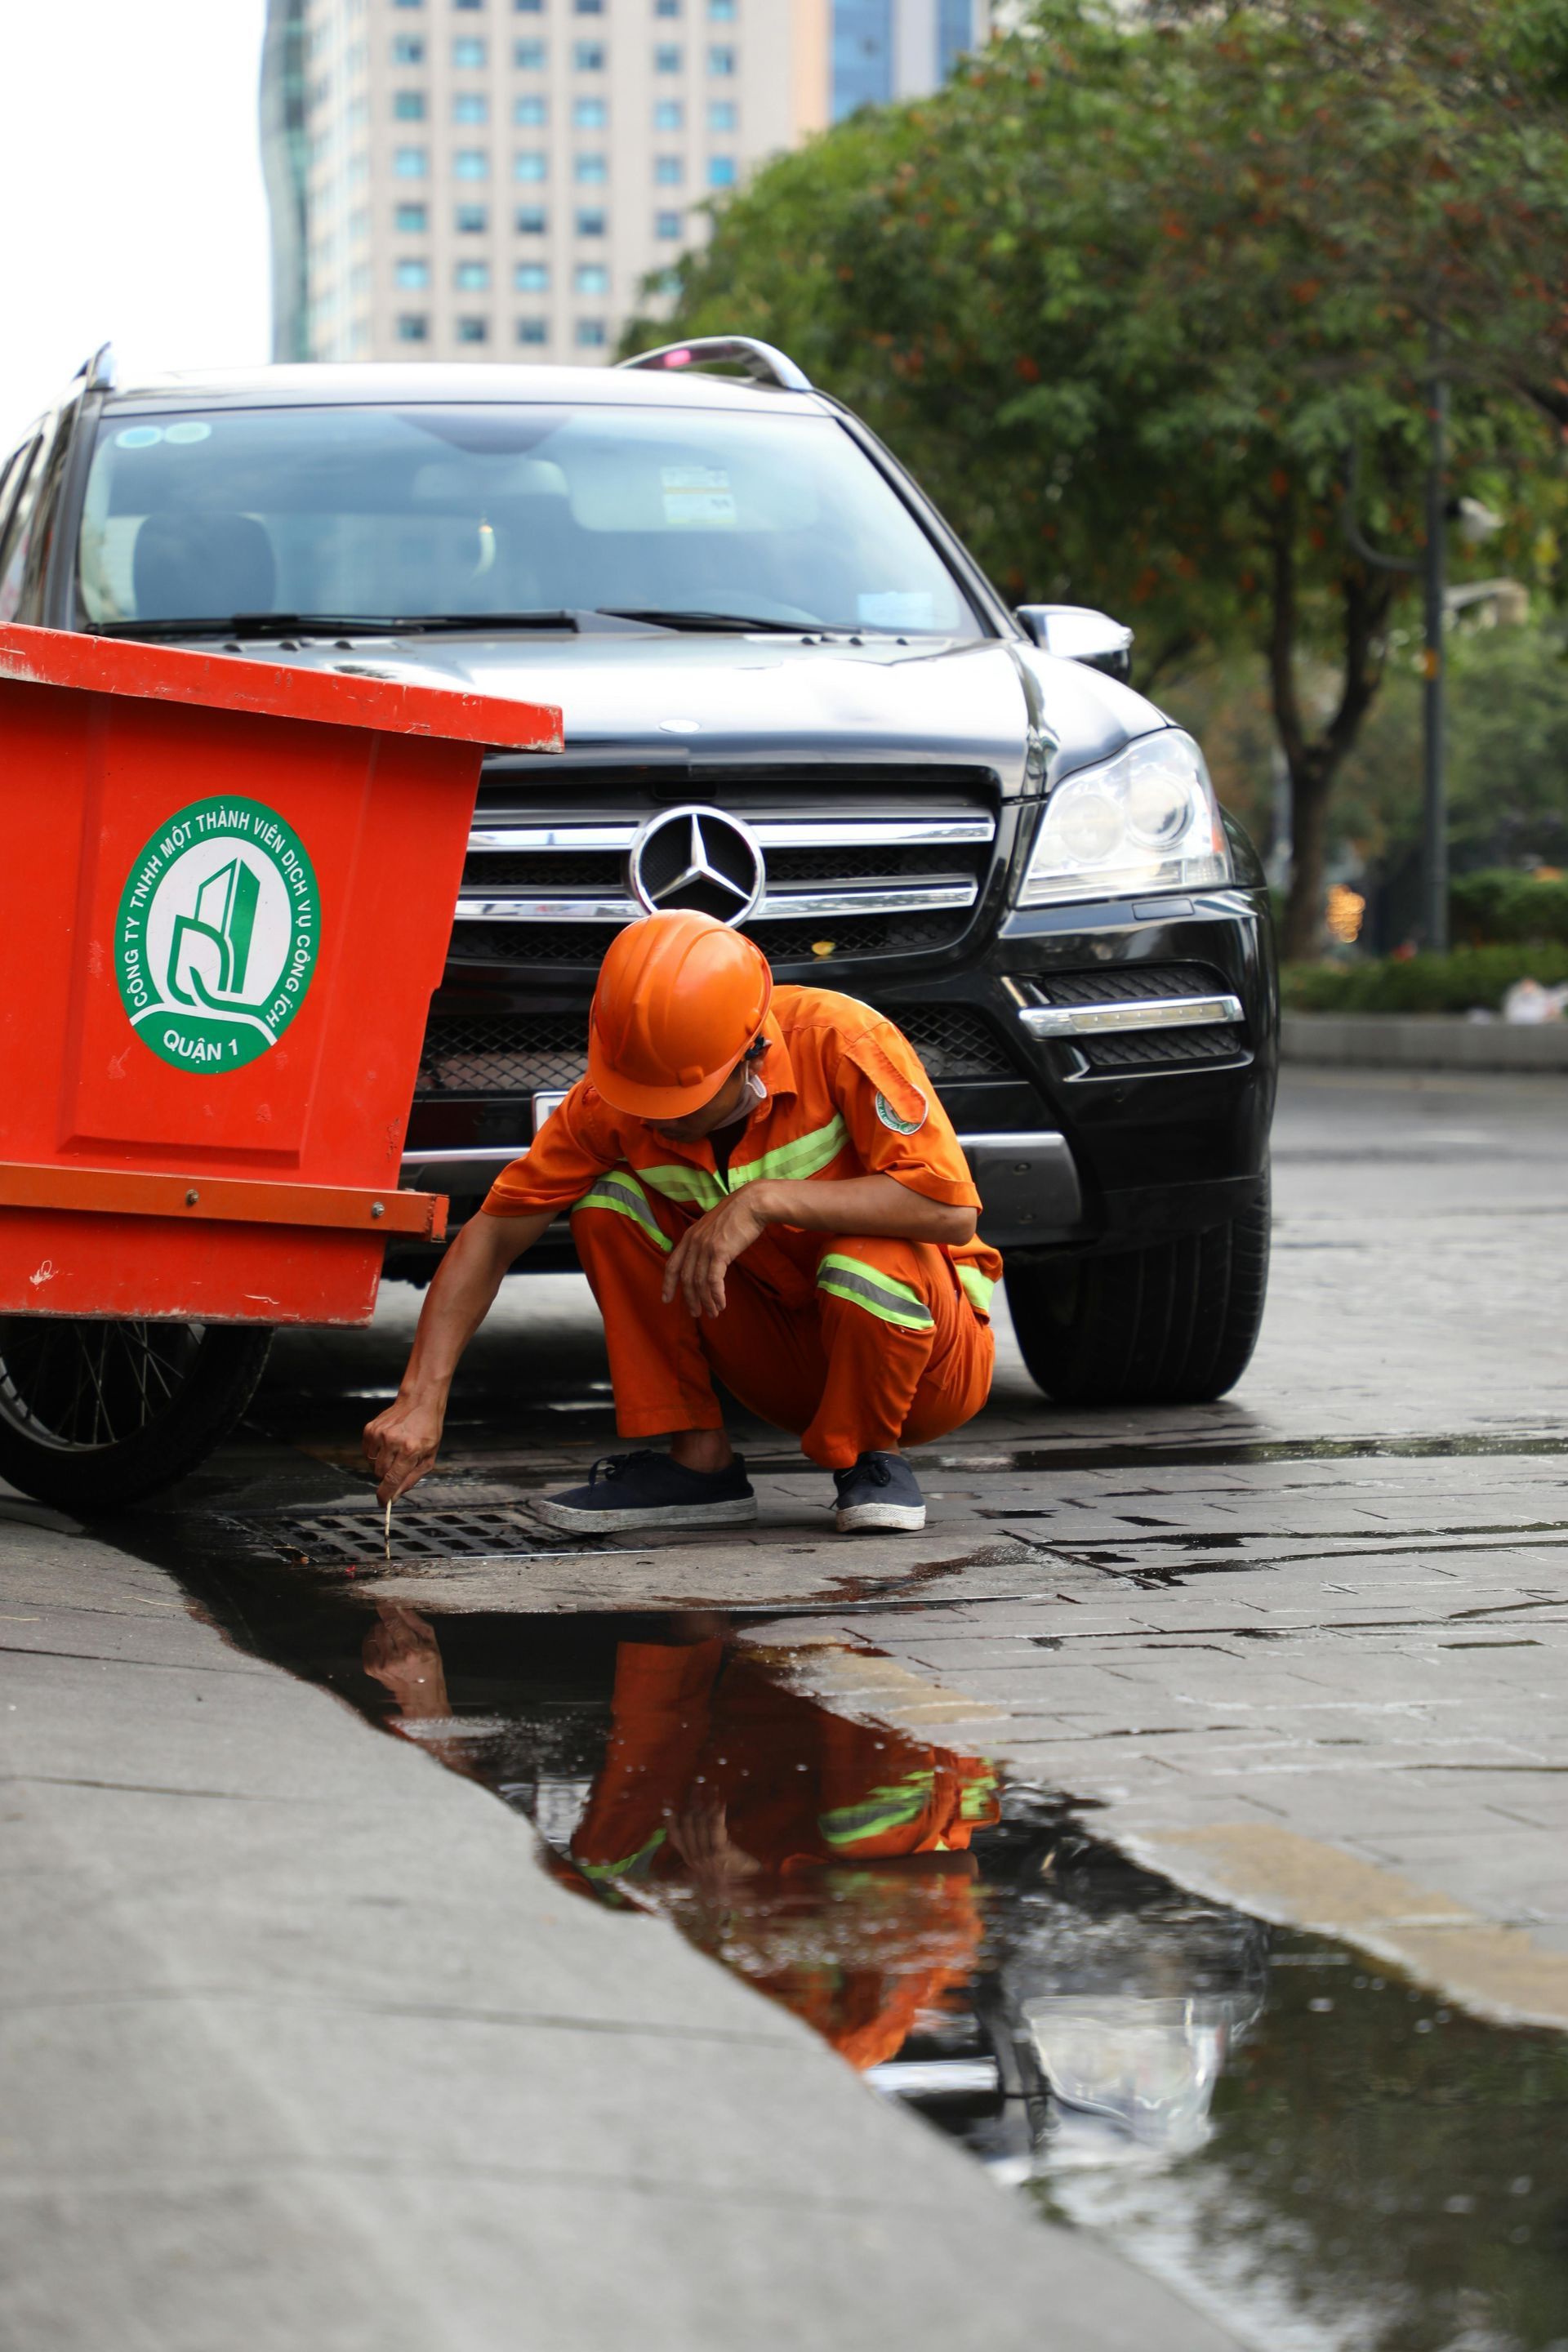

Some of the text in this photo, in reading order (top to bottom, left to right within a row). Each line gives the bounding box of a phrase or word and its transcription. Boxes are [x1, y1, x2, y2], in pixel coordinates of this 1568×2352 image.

[124, 805, 311, 1028] CÔNG TY TNHH MỘT THÀNH VIÊN DỊCH VỤ CÔNG ÍCH
[163, 1029, 238, 1064] QUẬN 1
